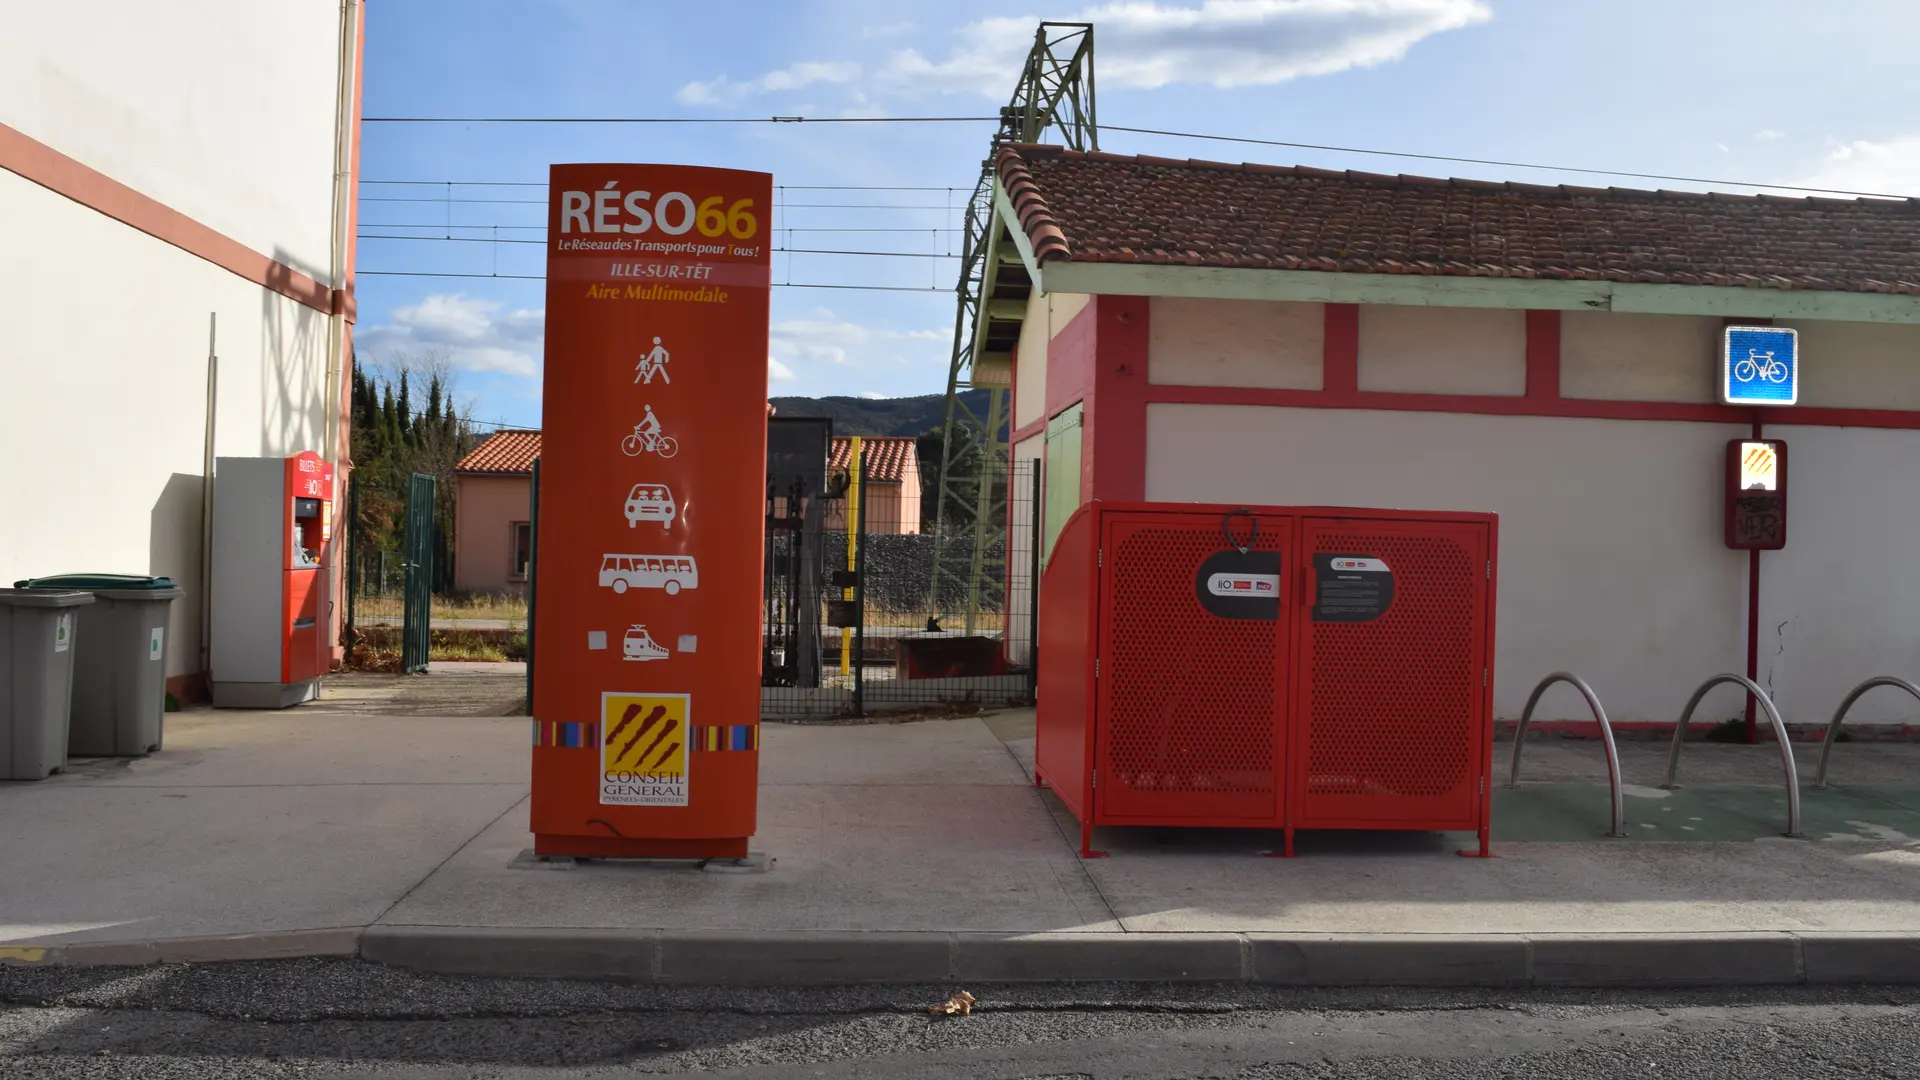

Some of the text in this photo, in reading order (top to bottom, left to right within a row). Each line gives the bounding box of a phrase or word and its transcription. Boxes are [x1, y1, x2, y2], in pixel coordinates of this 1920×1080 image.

[561, 181, 757, 239] RÉSO66
[558, 239, 571, 250] Le
[572, 239, 613, 251] Réseau
[613, 240, 632, 251] des
[634, 240, 696, 255] Transports
[696, 244, 725, 257] pour
[610, 263, 713, 280] ILLE-SUR-TÊT
[586, 283, 728, 303] Aire Multimodale
[604, 770, 684, 784] CONSEIL
